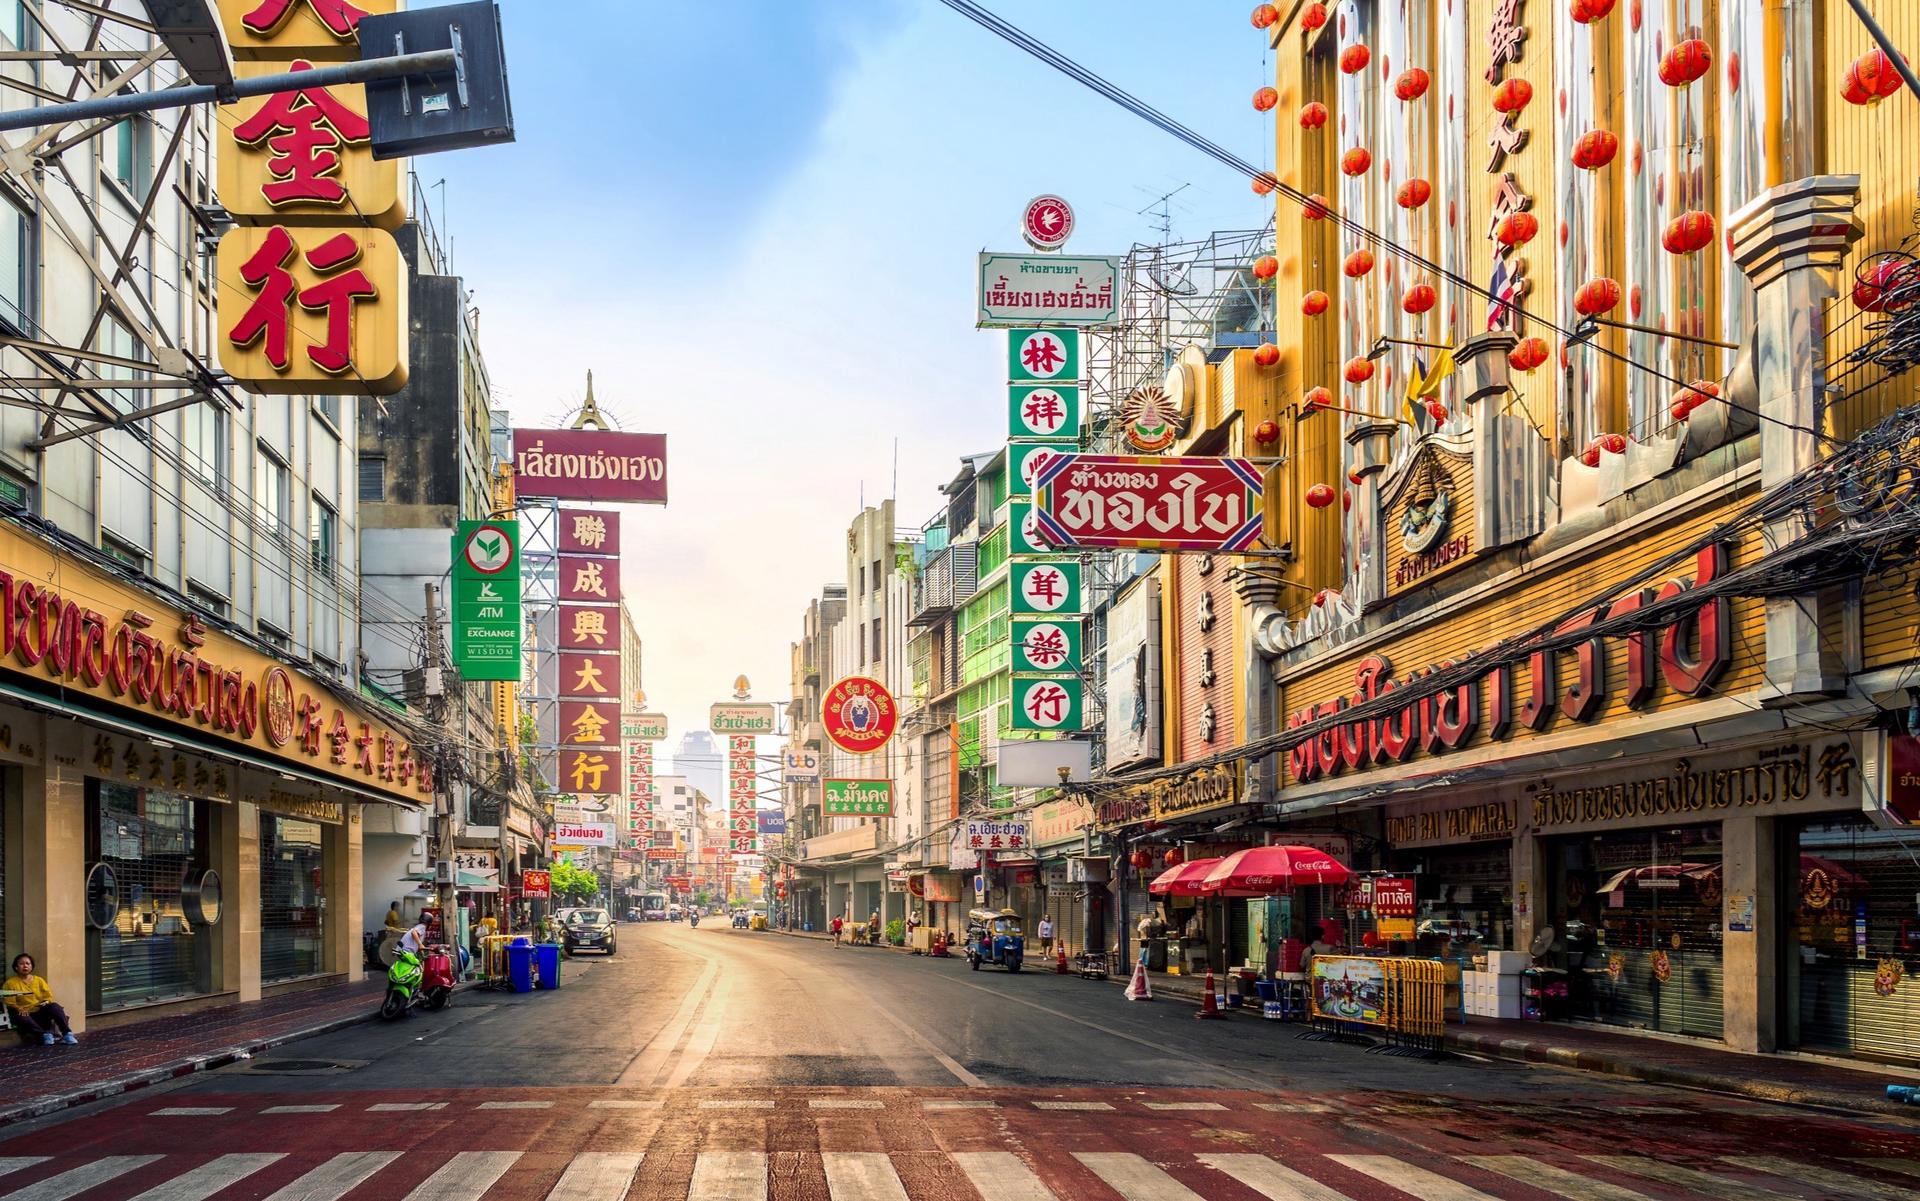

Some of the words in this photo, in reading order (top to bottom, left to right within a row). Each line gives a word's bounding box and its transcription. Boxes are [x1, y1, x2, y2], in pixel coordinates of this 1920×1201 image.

[1020, 261, 1079, 274] ห้างขายยา
[517, 440, 664, 481] เลี่ยงเซ่งเฮง
[1070, 465, 1159, 489] ห้างทอง
[1059, 472, 1240, 535] ทองใบ
[478, 607, 503, 618] ATM
[467, 630, 516, 638] EXCHANGE
[572, 516, 608, 792] 聯成興大金行
[788, 754, 816, 769] ttb
[635, 744, 648, 850] 和成興大金行
[735, 738, 751, 853] 和成興大金行
[826, 782, 889, 803] ฉ.มั่นคง
[766, 818, 784, 826] UOB
[1420, 811, 1440, 840] BAI
[1446, 800, 1518, 838] YAOWARAJ
[1294, 860, 1332, 871] Coca-Cola
[1245, 875, 1273, 884] Coca-Cola
